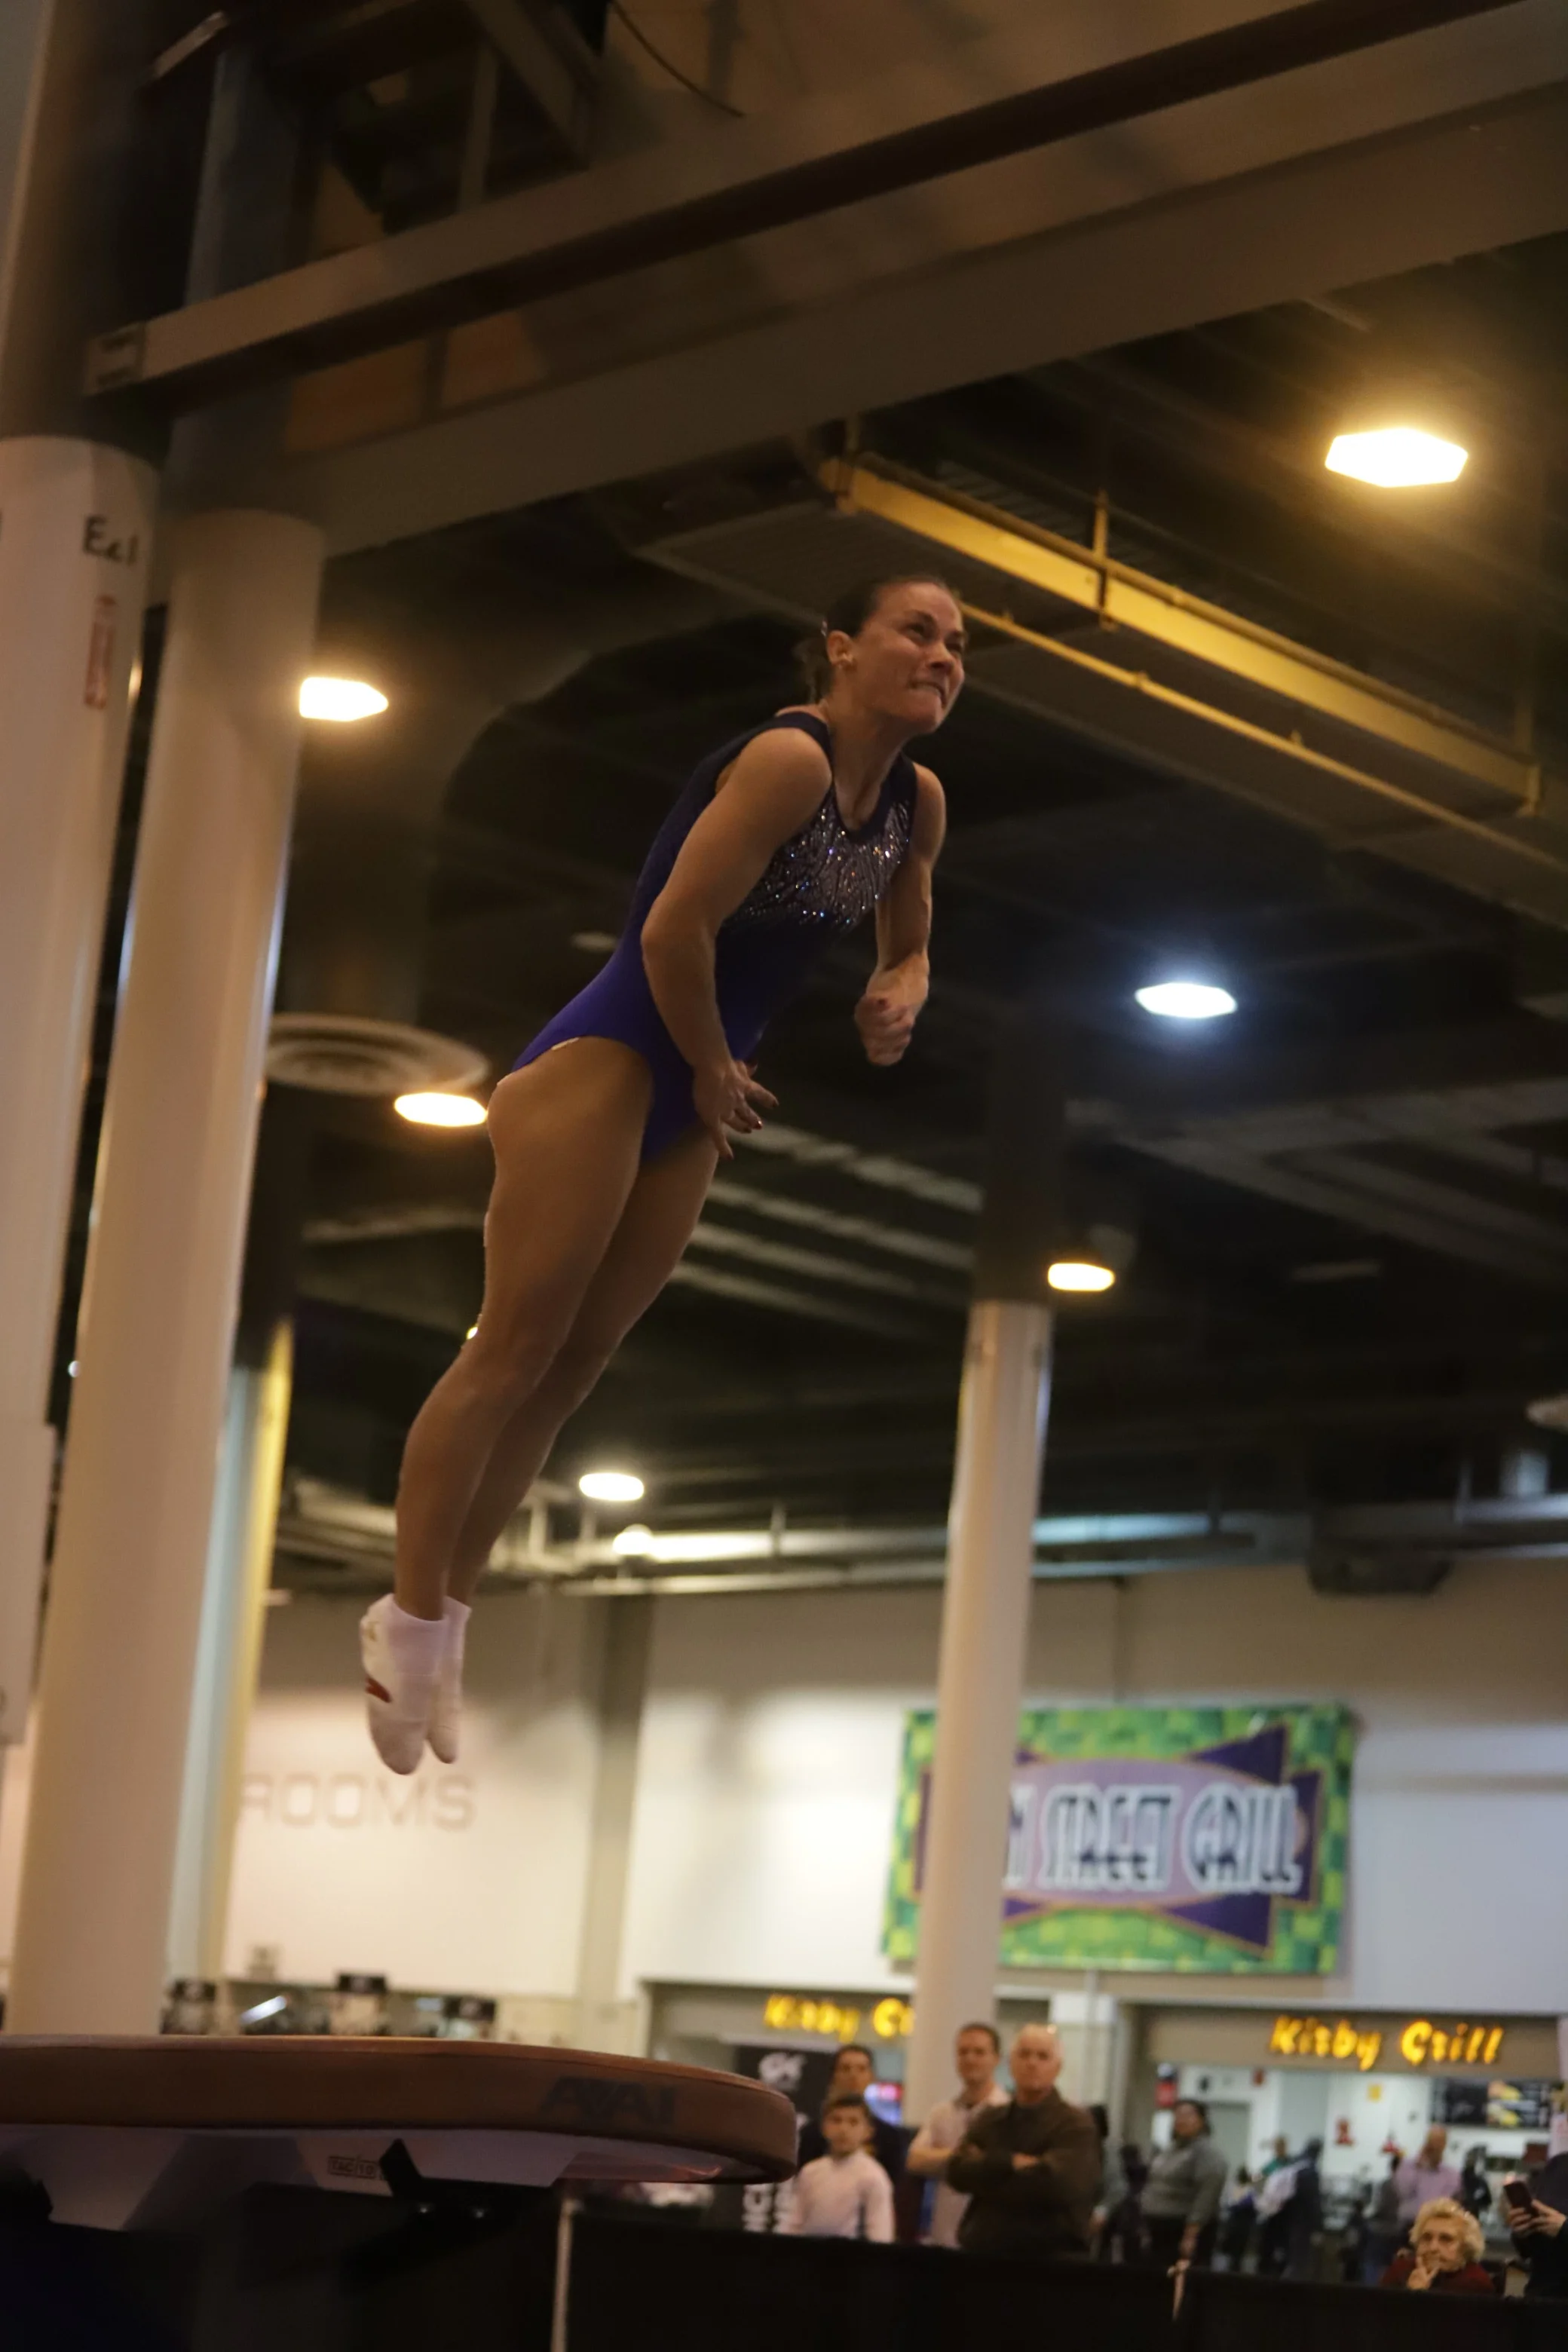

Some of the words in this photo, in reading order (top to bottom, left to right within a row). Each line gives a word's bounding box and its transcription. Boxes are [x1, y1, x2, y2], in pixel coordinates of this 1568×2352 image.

[1038, 1782, 1181, 1893] STREET
[1182, 1782, 1303, 1895] GRILL
[1400, 2020, 1504, 2066] Grill
